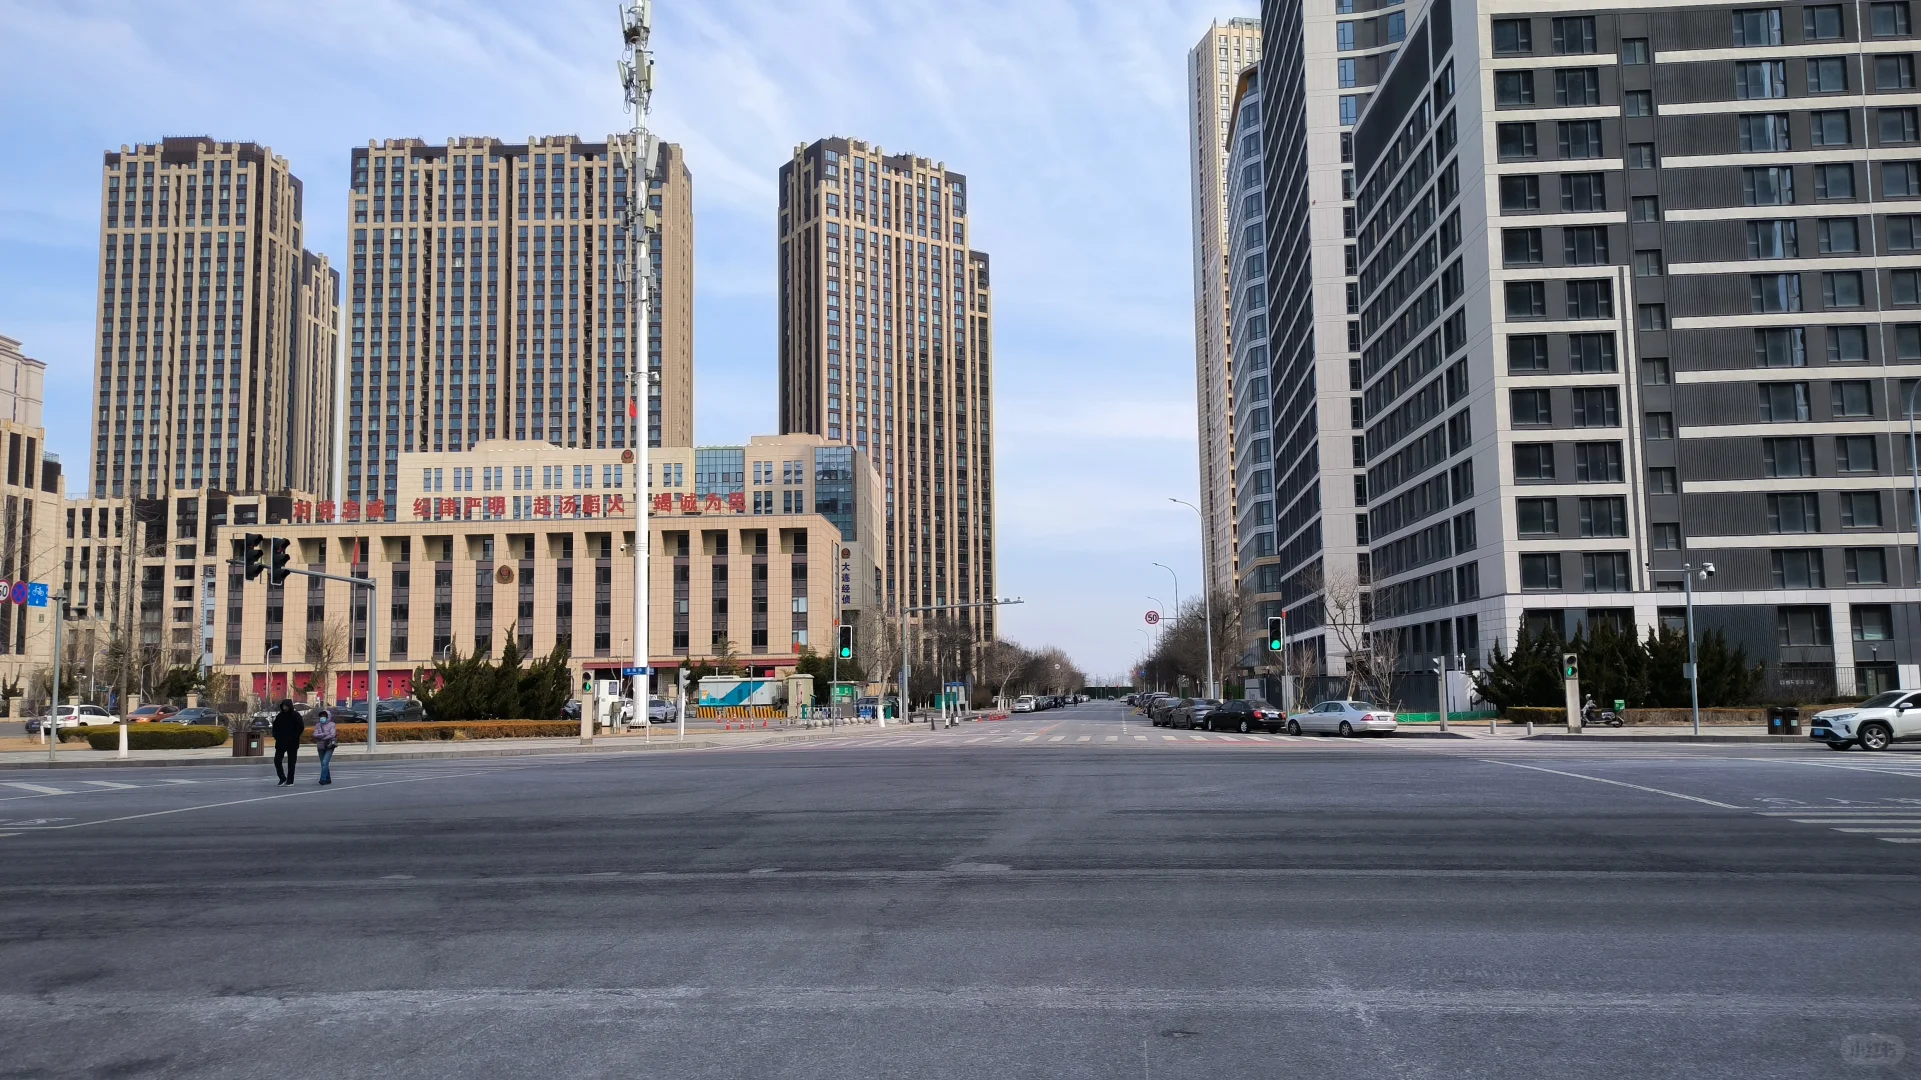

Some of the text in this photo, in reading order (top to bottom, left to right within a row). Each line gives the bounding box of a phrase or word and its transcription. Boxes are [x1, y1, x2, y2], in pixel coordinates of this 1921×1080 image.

[293, 493, 746, 519] 对党忠诚 纪律严明 赴汤蹈火 竭诚为民
[842, 562, 851, 604] 大连经侦
[1148, 614, 1157, 622] 50
